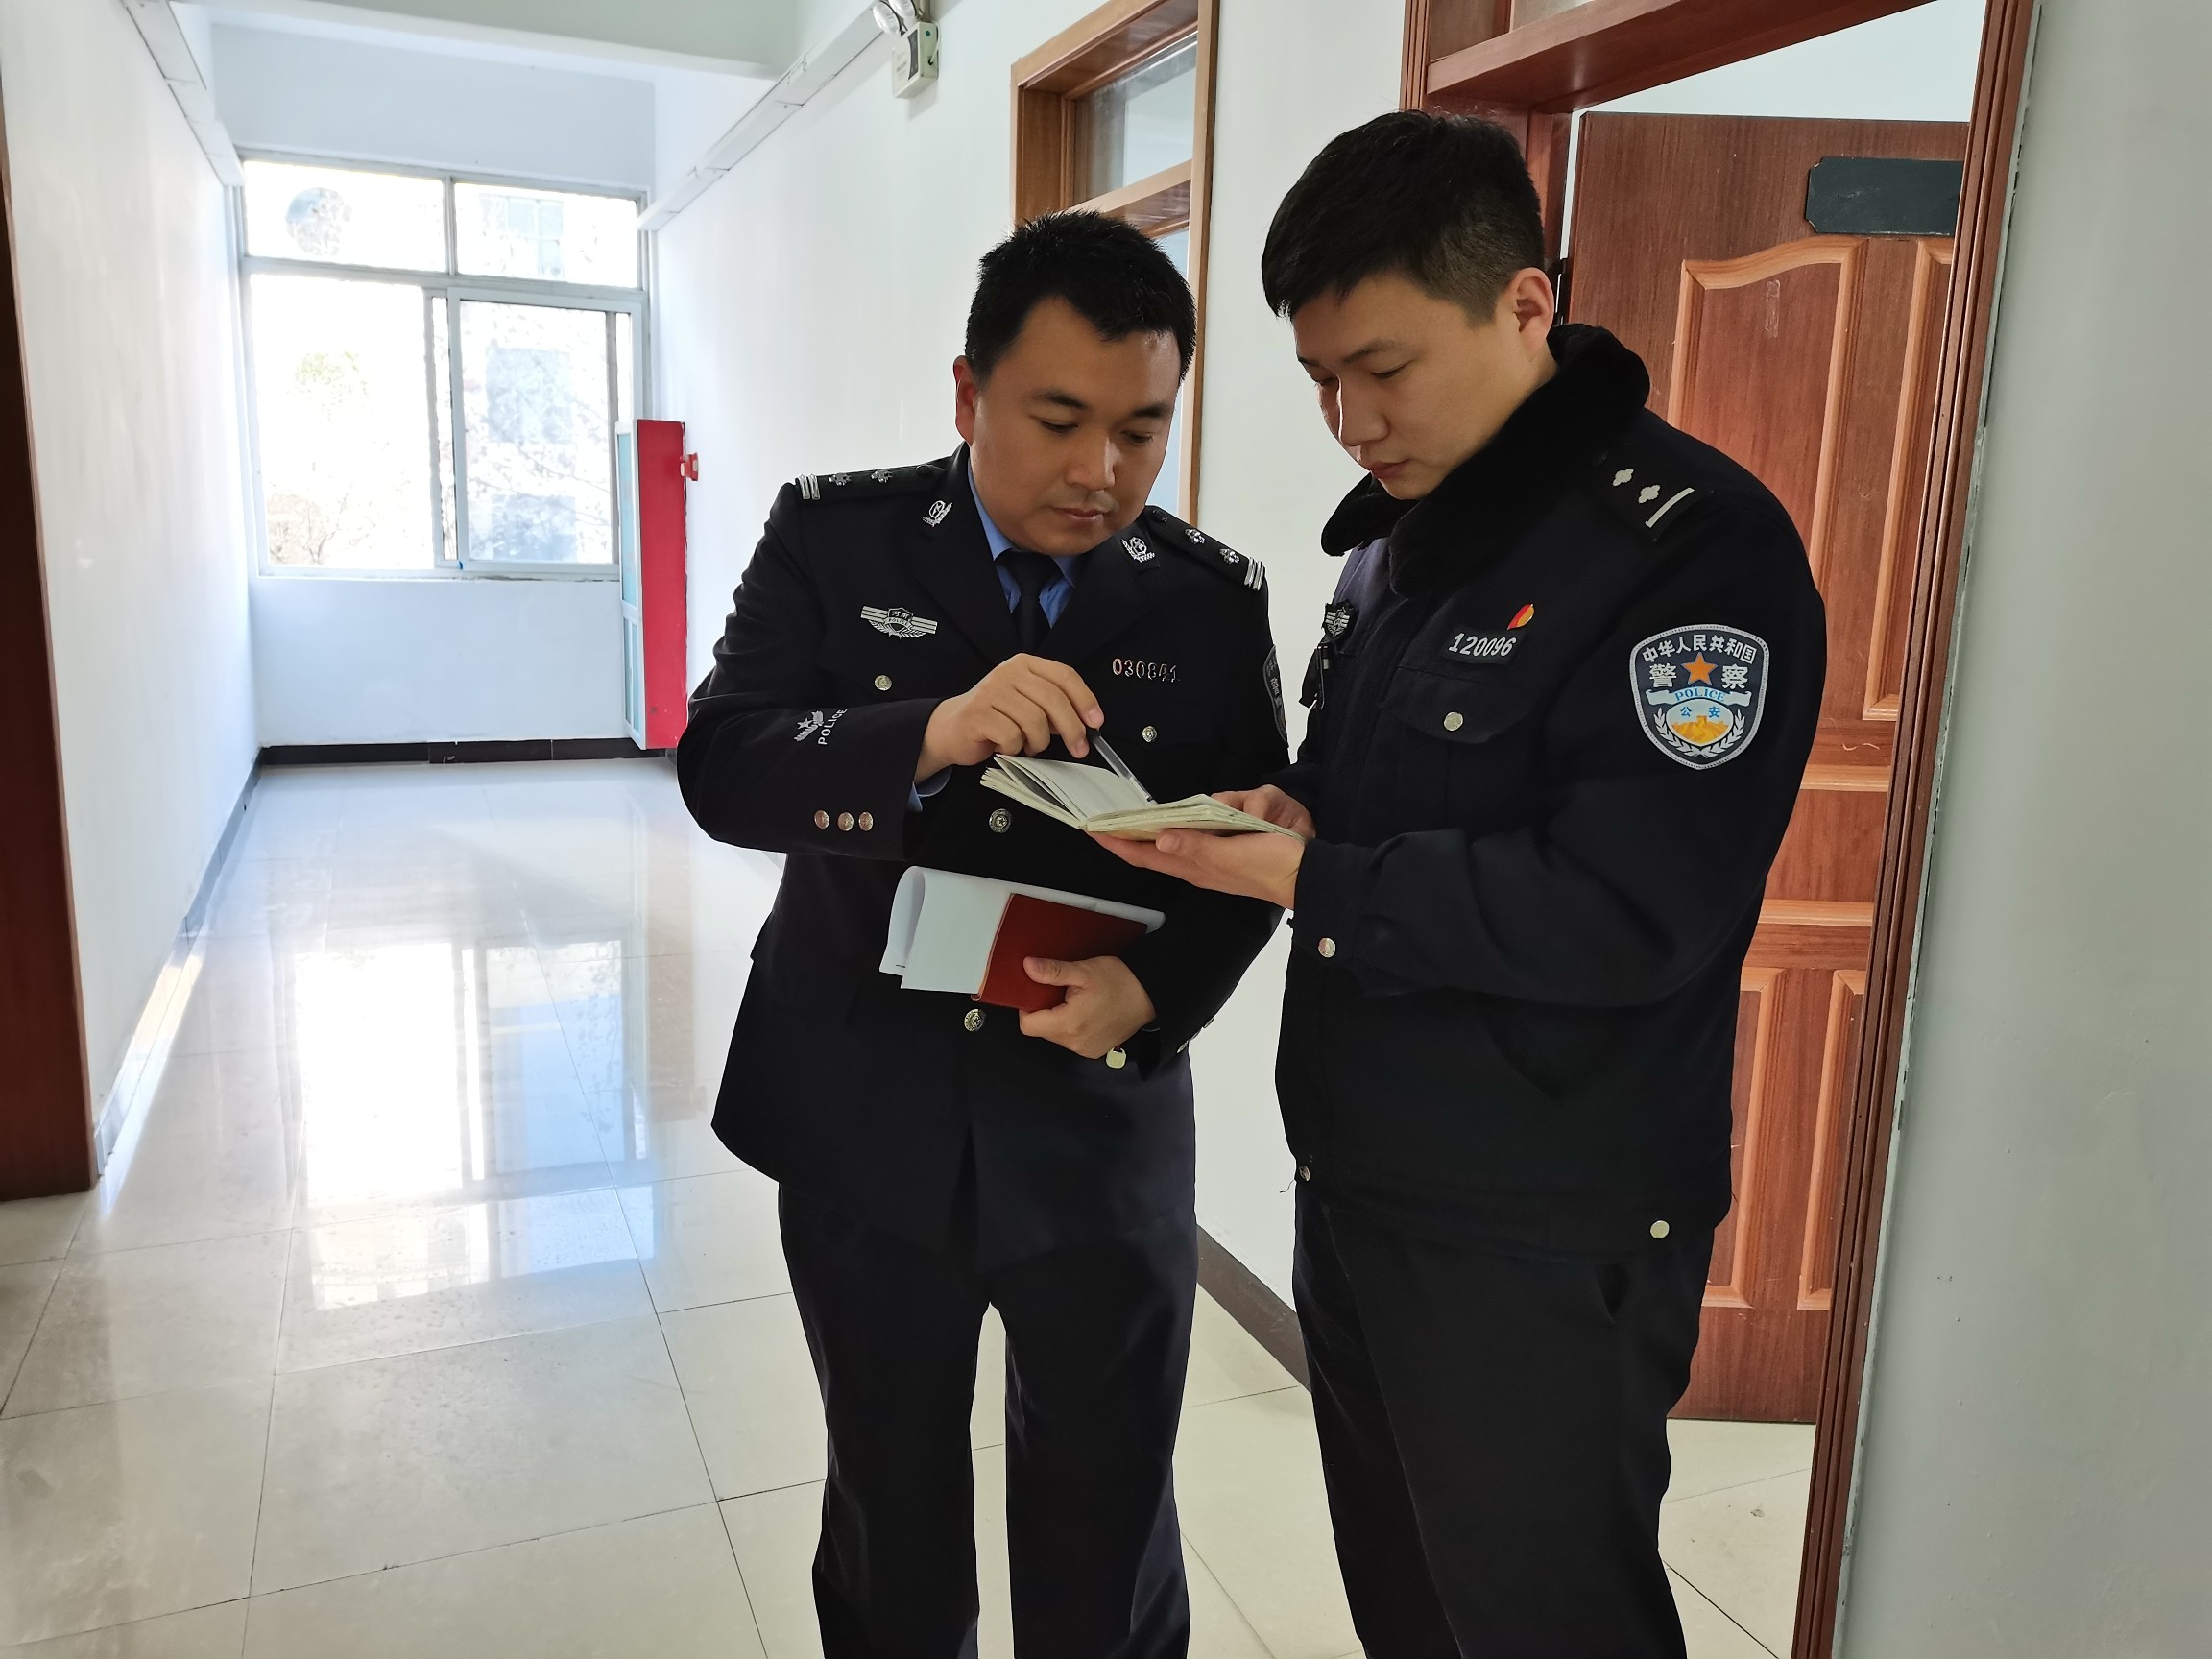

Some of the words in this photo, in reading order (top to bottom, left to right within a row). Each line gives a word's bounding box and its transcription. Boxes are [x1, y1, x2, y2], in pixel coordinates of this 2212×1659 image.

[1448, 633, 1517, 657] 120096
[1642, 634, 1758, 664] 中华人民共和国
[1674, 687, 1726, 702] POLICE
[1680, 706, 1721, 718] 公安
[817, 709, 848, 745] POLICE
